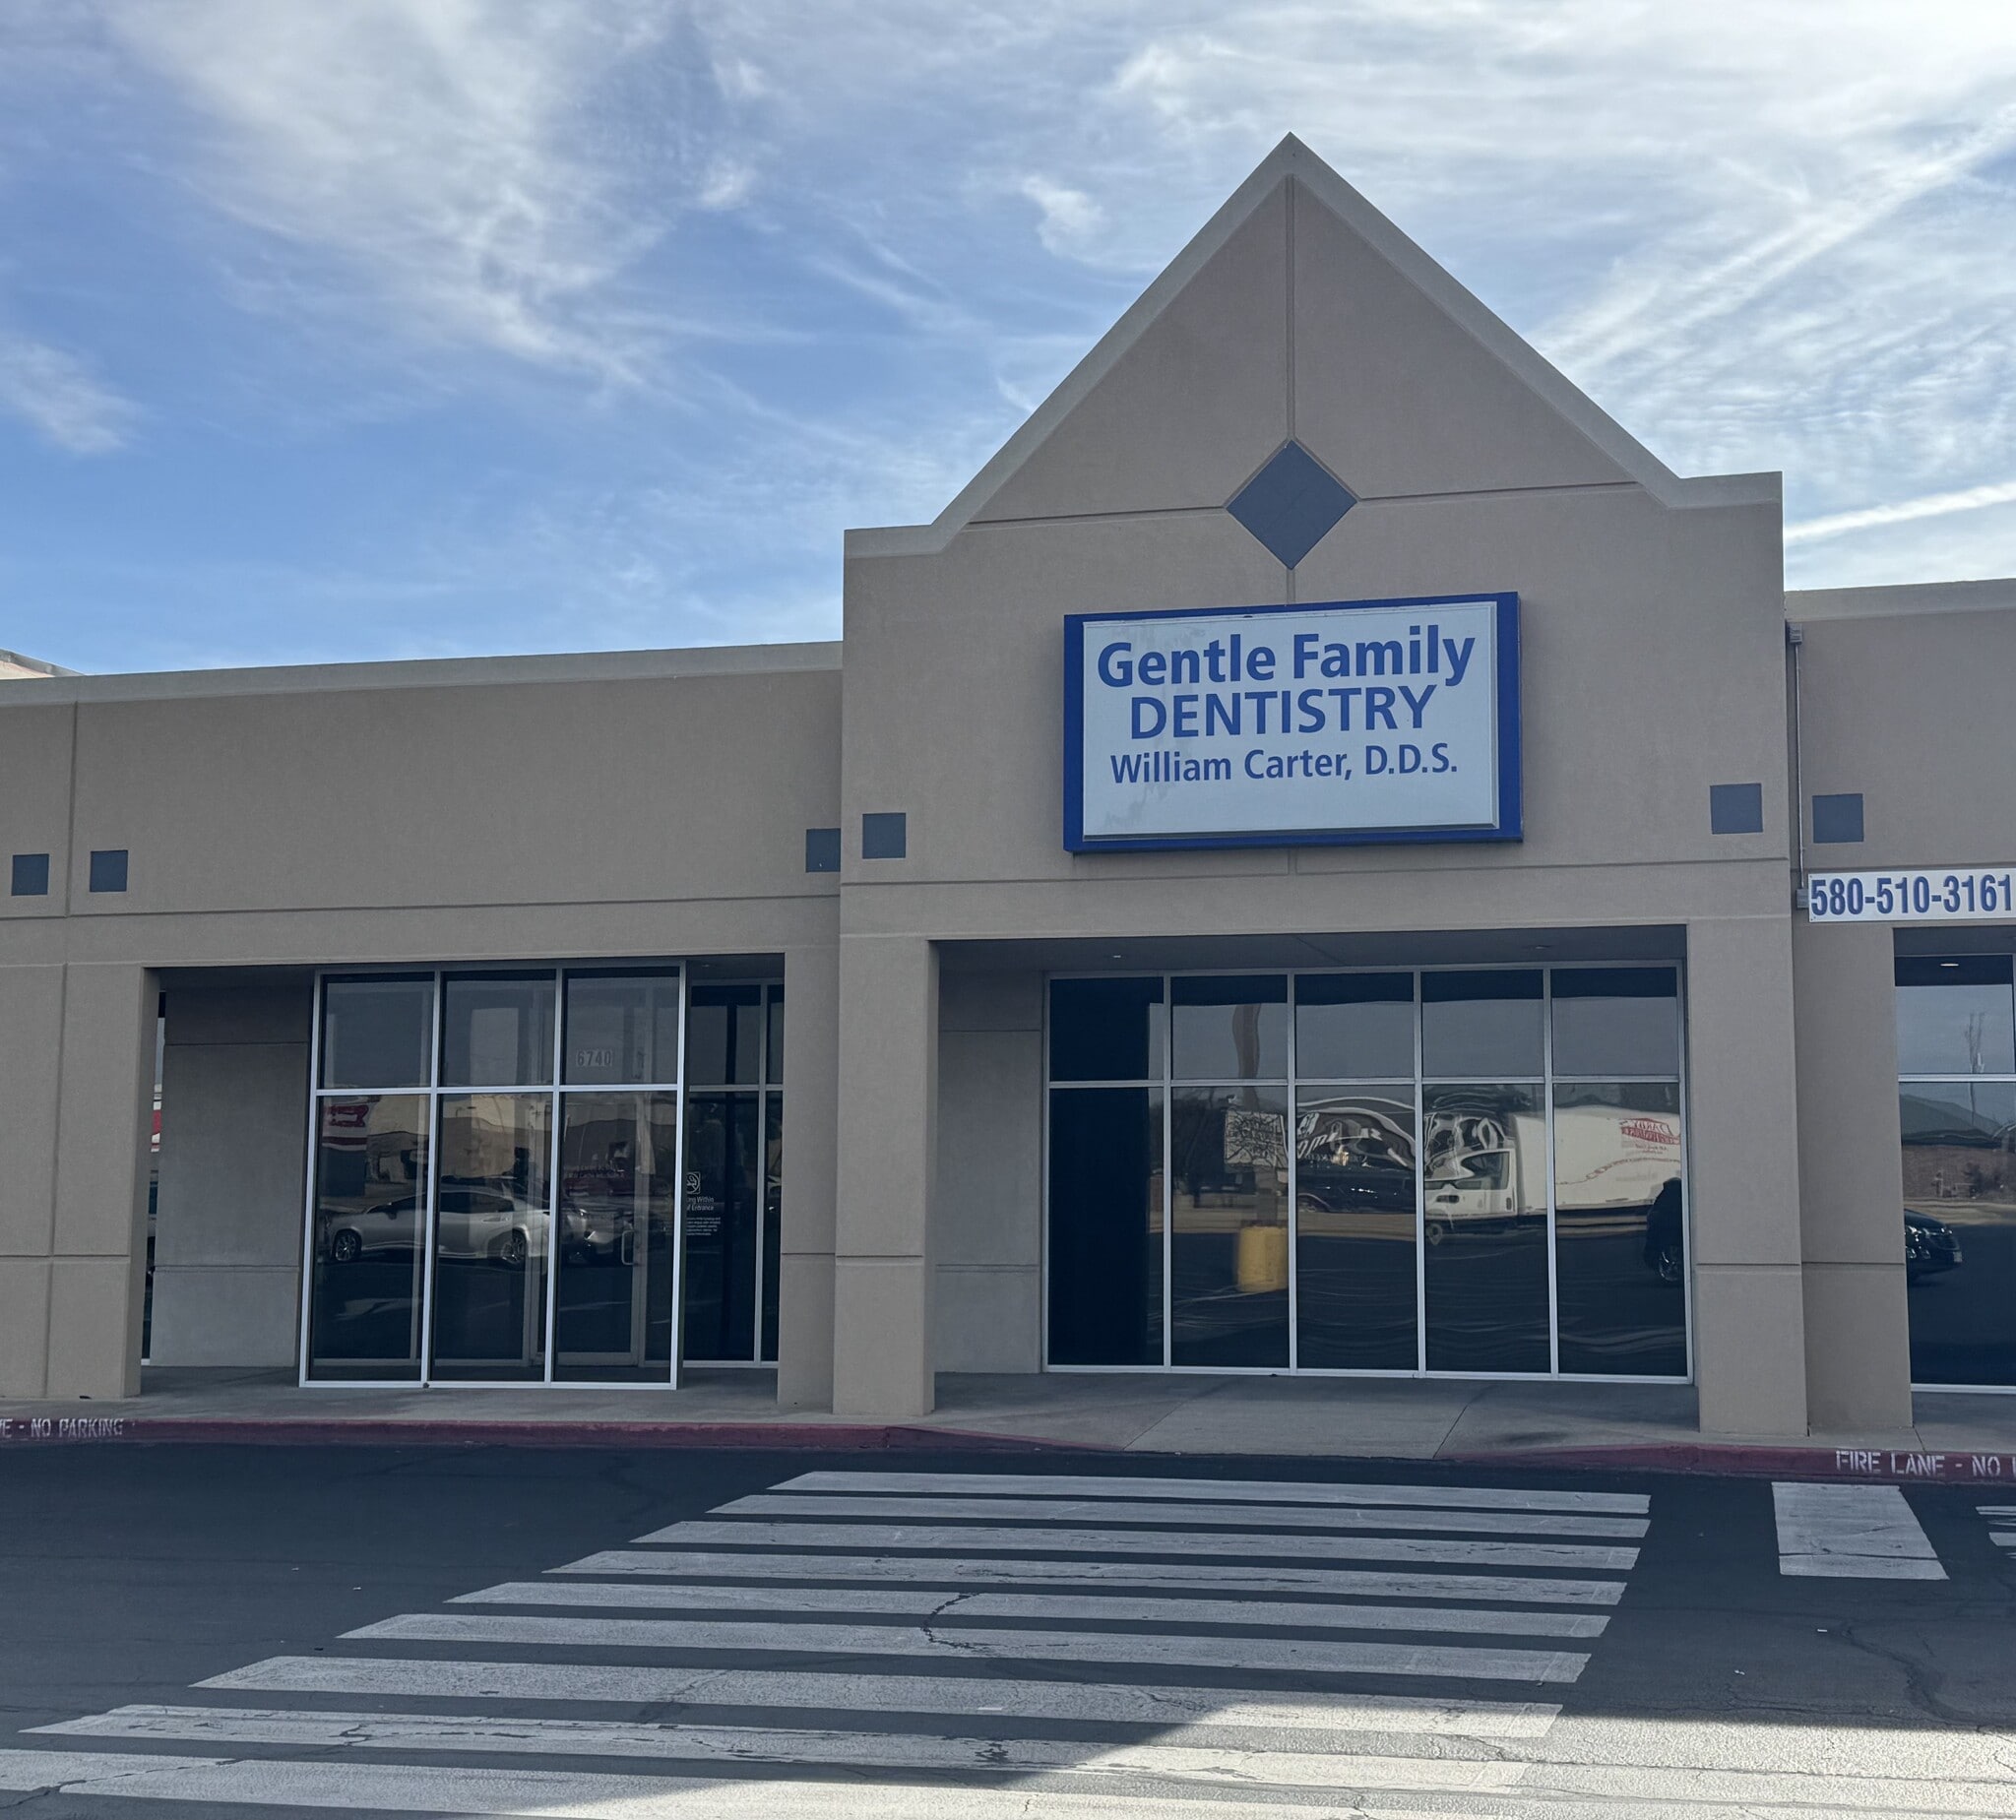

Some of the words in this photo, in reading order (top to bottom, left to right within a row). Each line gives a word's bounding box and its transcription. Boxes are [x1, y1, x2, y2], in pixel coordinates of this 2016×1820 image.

[1098, 633, 1277, 687] Gentle
[1292, 624, 1476, 686] Family
[1131, 684, 1437, 739] DENTISTRY
[1110, 751, 1231, 784] William
[1244, 749, 1353, 781] Carter,
[1365, 742, 1458, 776] D.D.S.
[1810, 874, 2011, 915] 580-510-3161
[577, 1050, 612, 1066] 6740
[31, 1418, 51, 1438] NO
[59, 1418, 124, 1438] PARKING
[1836, 1450, 1882, 1475] FIRE
[1890, 1452, 1946, 1476] LANE
[1972, 1455, 2001, 1477] NO
